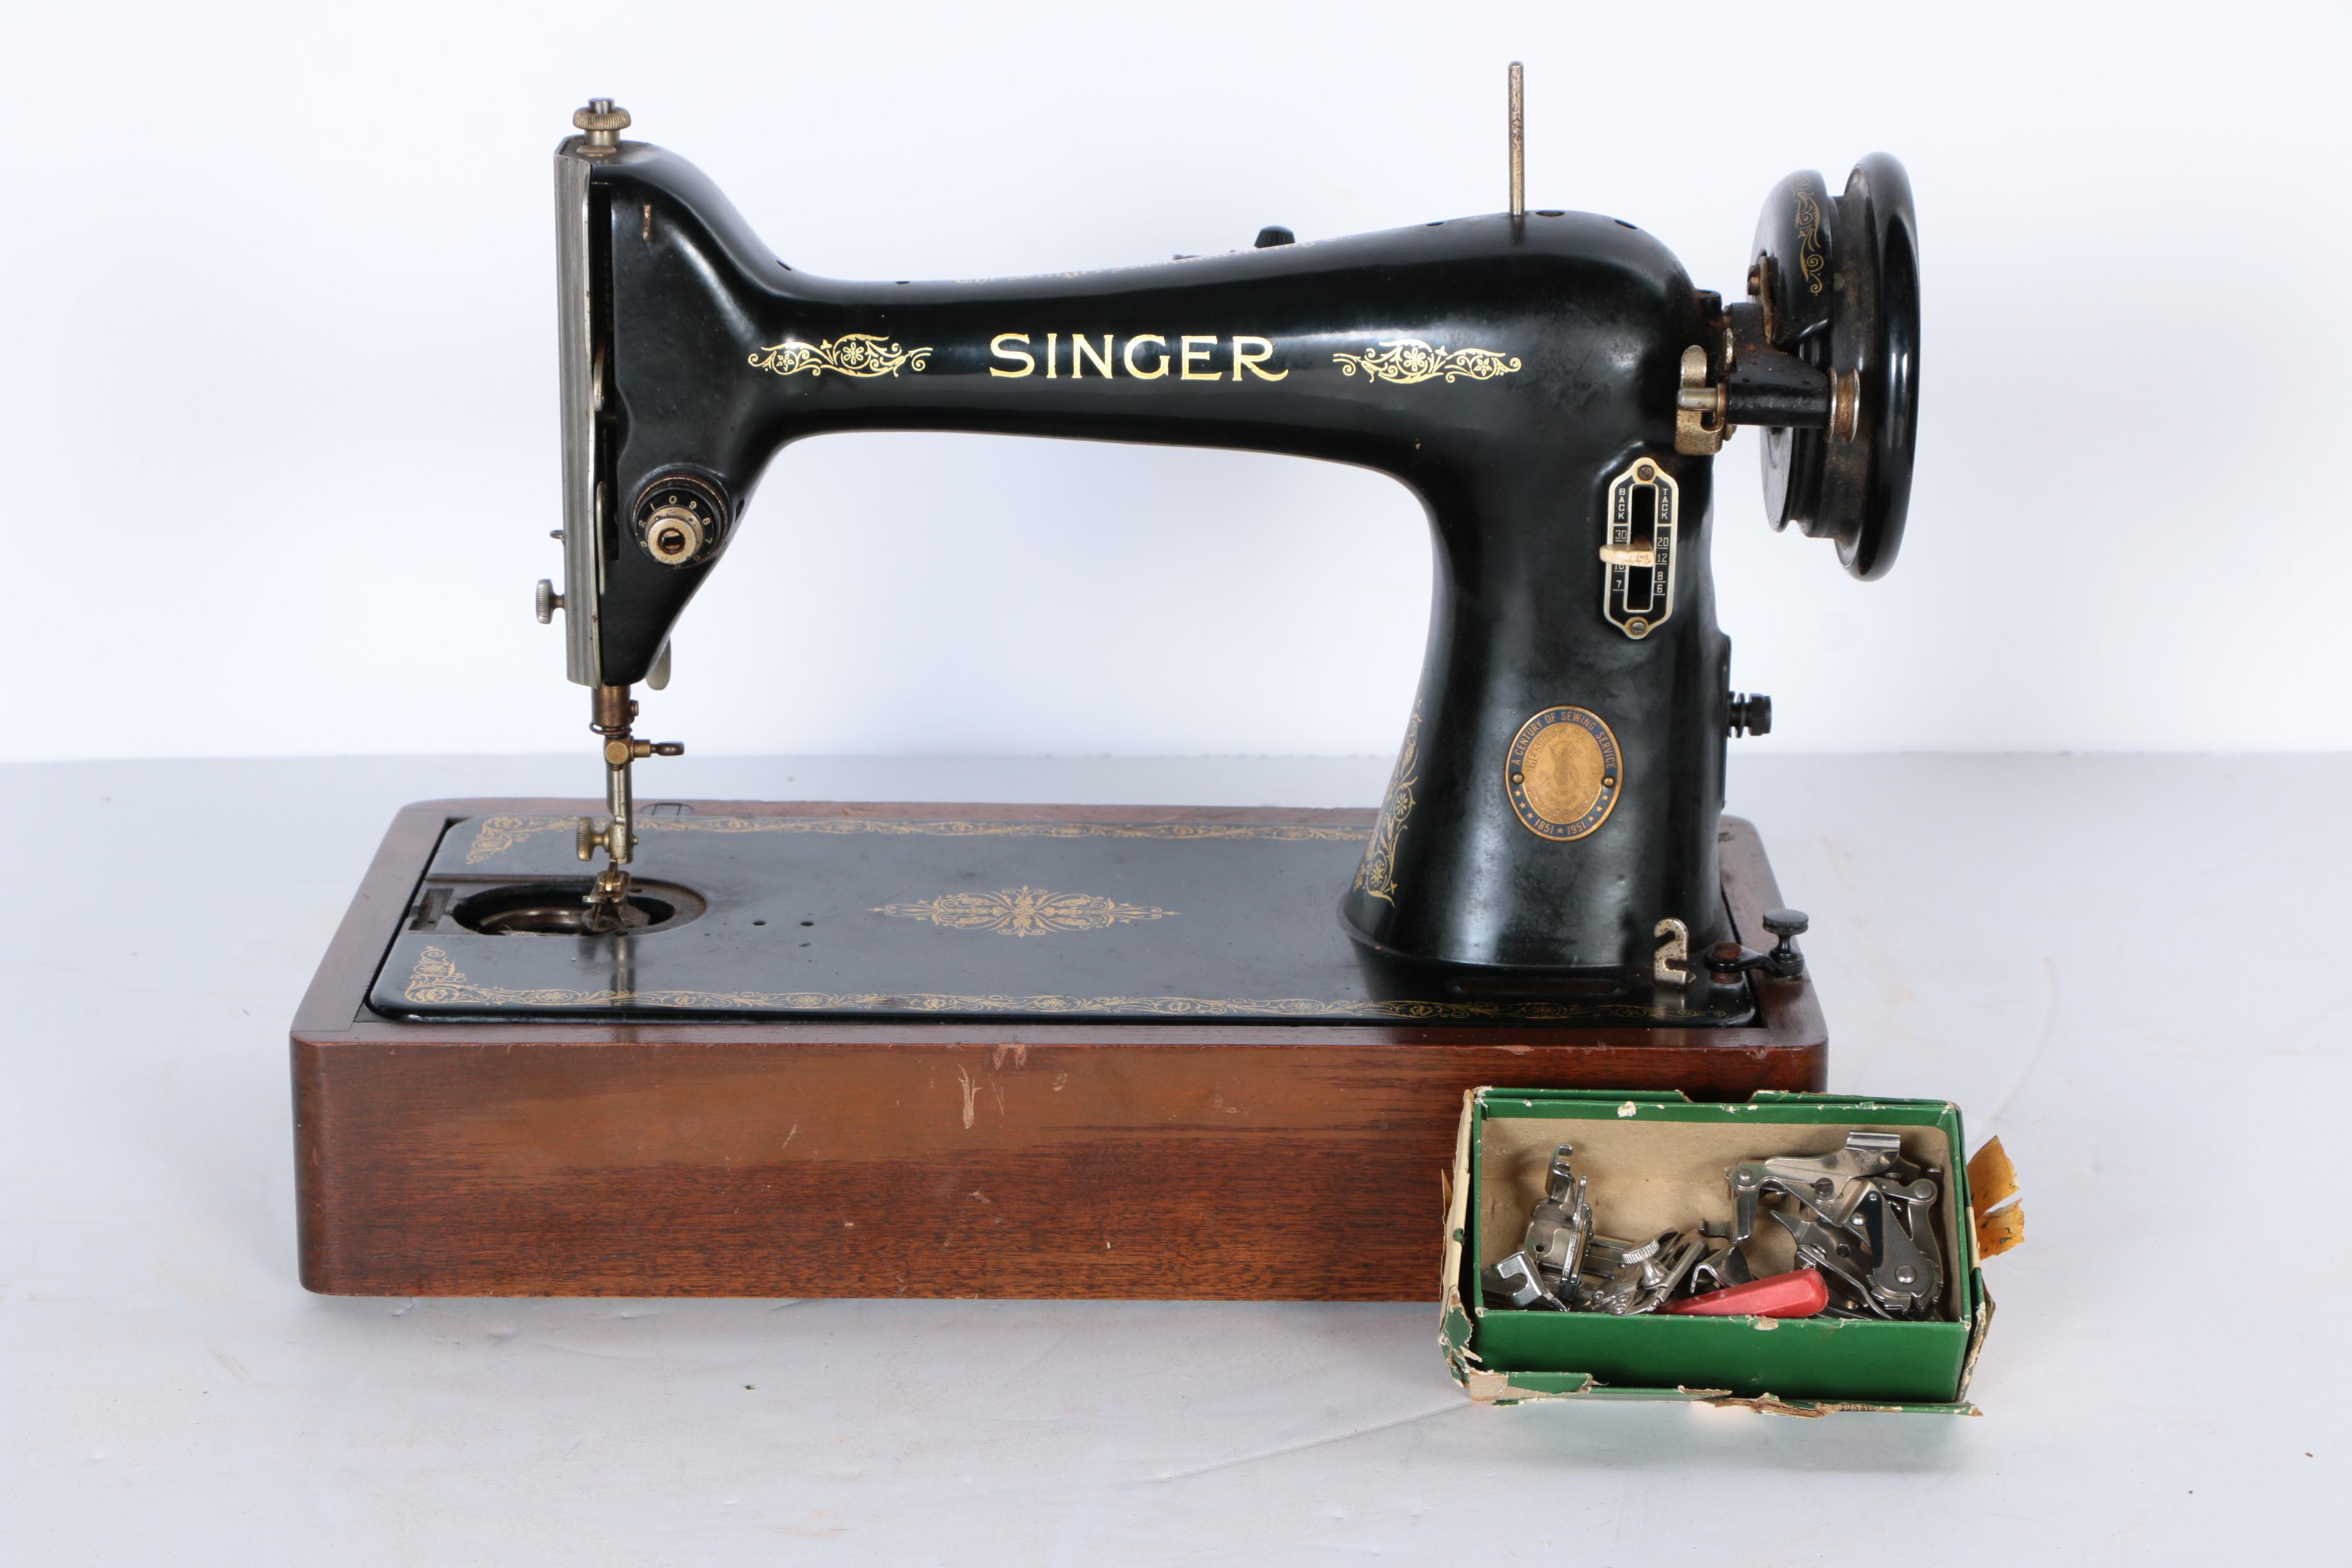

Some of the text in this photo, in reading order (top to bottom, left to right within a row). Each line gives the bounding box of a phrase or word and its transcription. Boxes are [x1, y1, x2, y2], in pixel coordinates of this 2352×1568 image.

[989, 332, 1289, 382] SINGER
[669, 496, 677, 504] 0
[689, 501, 697, 509] 9
[638, 520, 645, 528] 2
[1615, 530, 1627, 540] 30
[1657, 537, 1669, 547] 20
[1658, 553, 1667, 563] 12
[1658, 572, 1663, 580] 8
[1656, 584, 1663, 594] 6
[1516, 720, 1542, 756] CENTURY
[1545, 712, 1556, 723] OF
[1561, 712, 1596, 730] SEWING
[1596, 732, 1616, 769] SERVICE
[1534, 819, 1587, 835] 1851 1951
